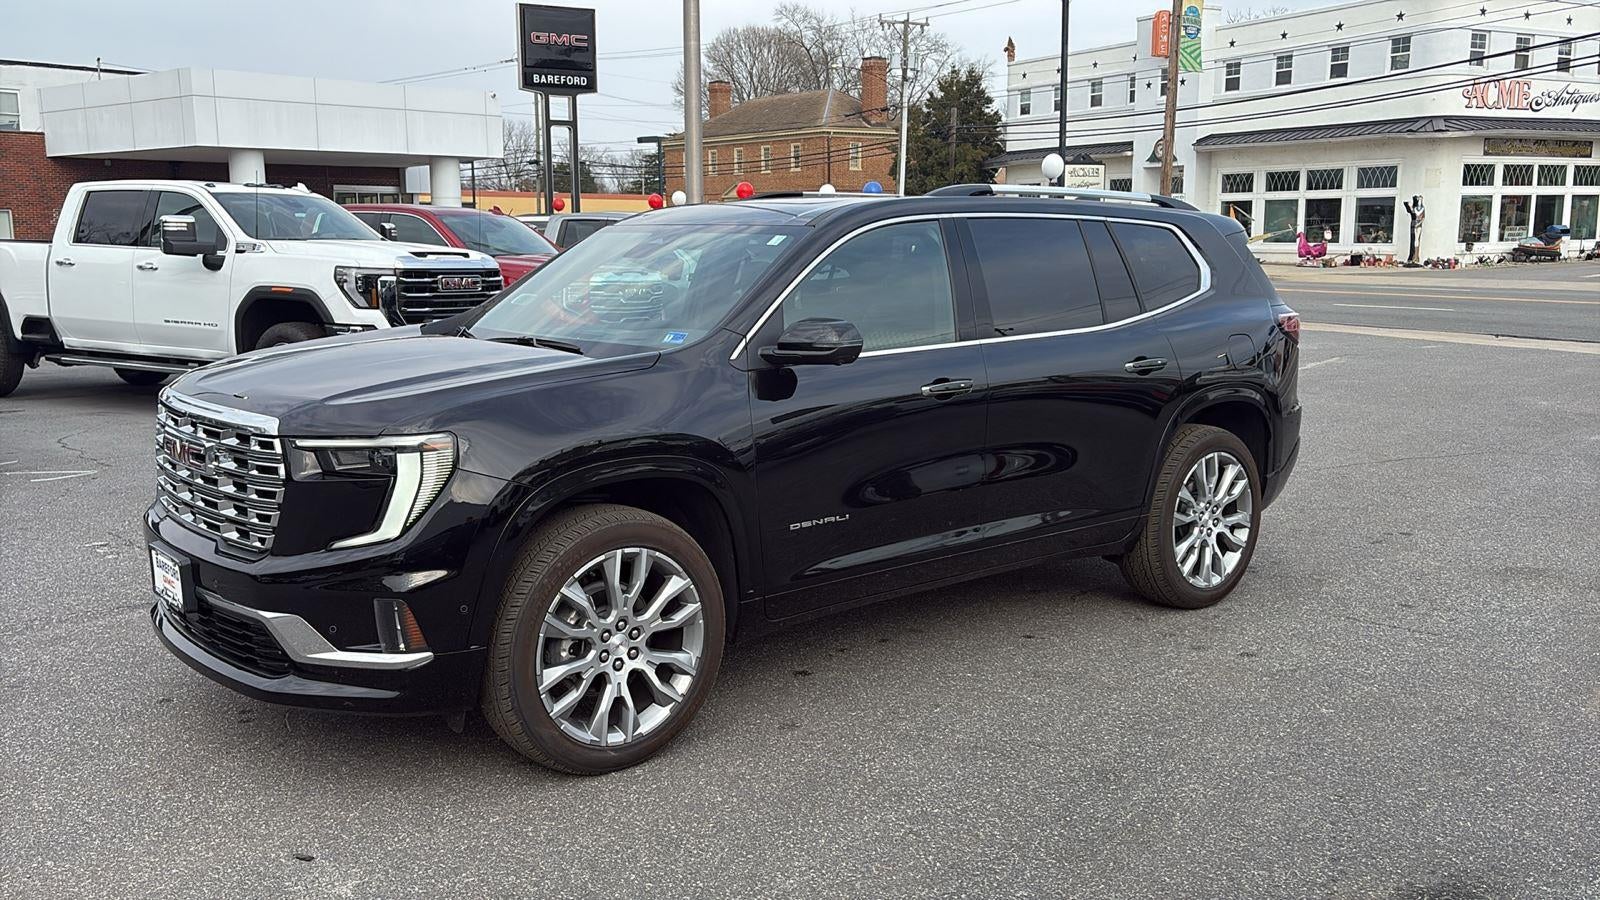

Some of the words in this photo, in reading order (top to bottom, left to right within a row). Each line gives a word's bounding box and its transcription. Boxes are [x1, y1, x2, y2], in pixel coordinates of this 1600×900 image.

[530, 31, 588, 47] GMC
[533, 74, 587, 86] BAREFORD
[1462, 78, 1531, 110] ACME
[442, 277, 480, 290] GMC
[163, 433, 204, 468] GMC
[789, 513, 850, 530] DENALI
